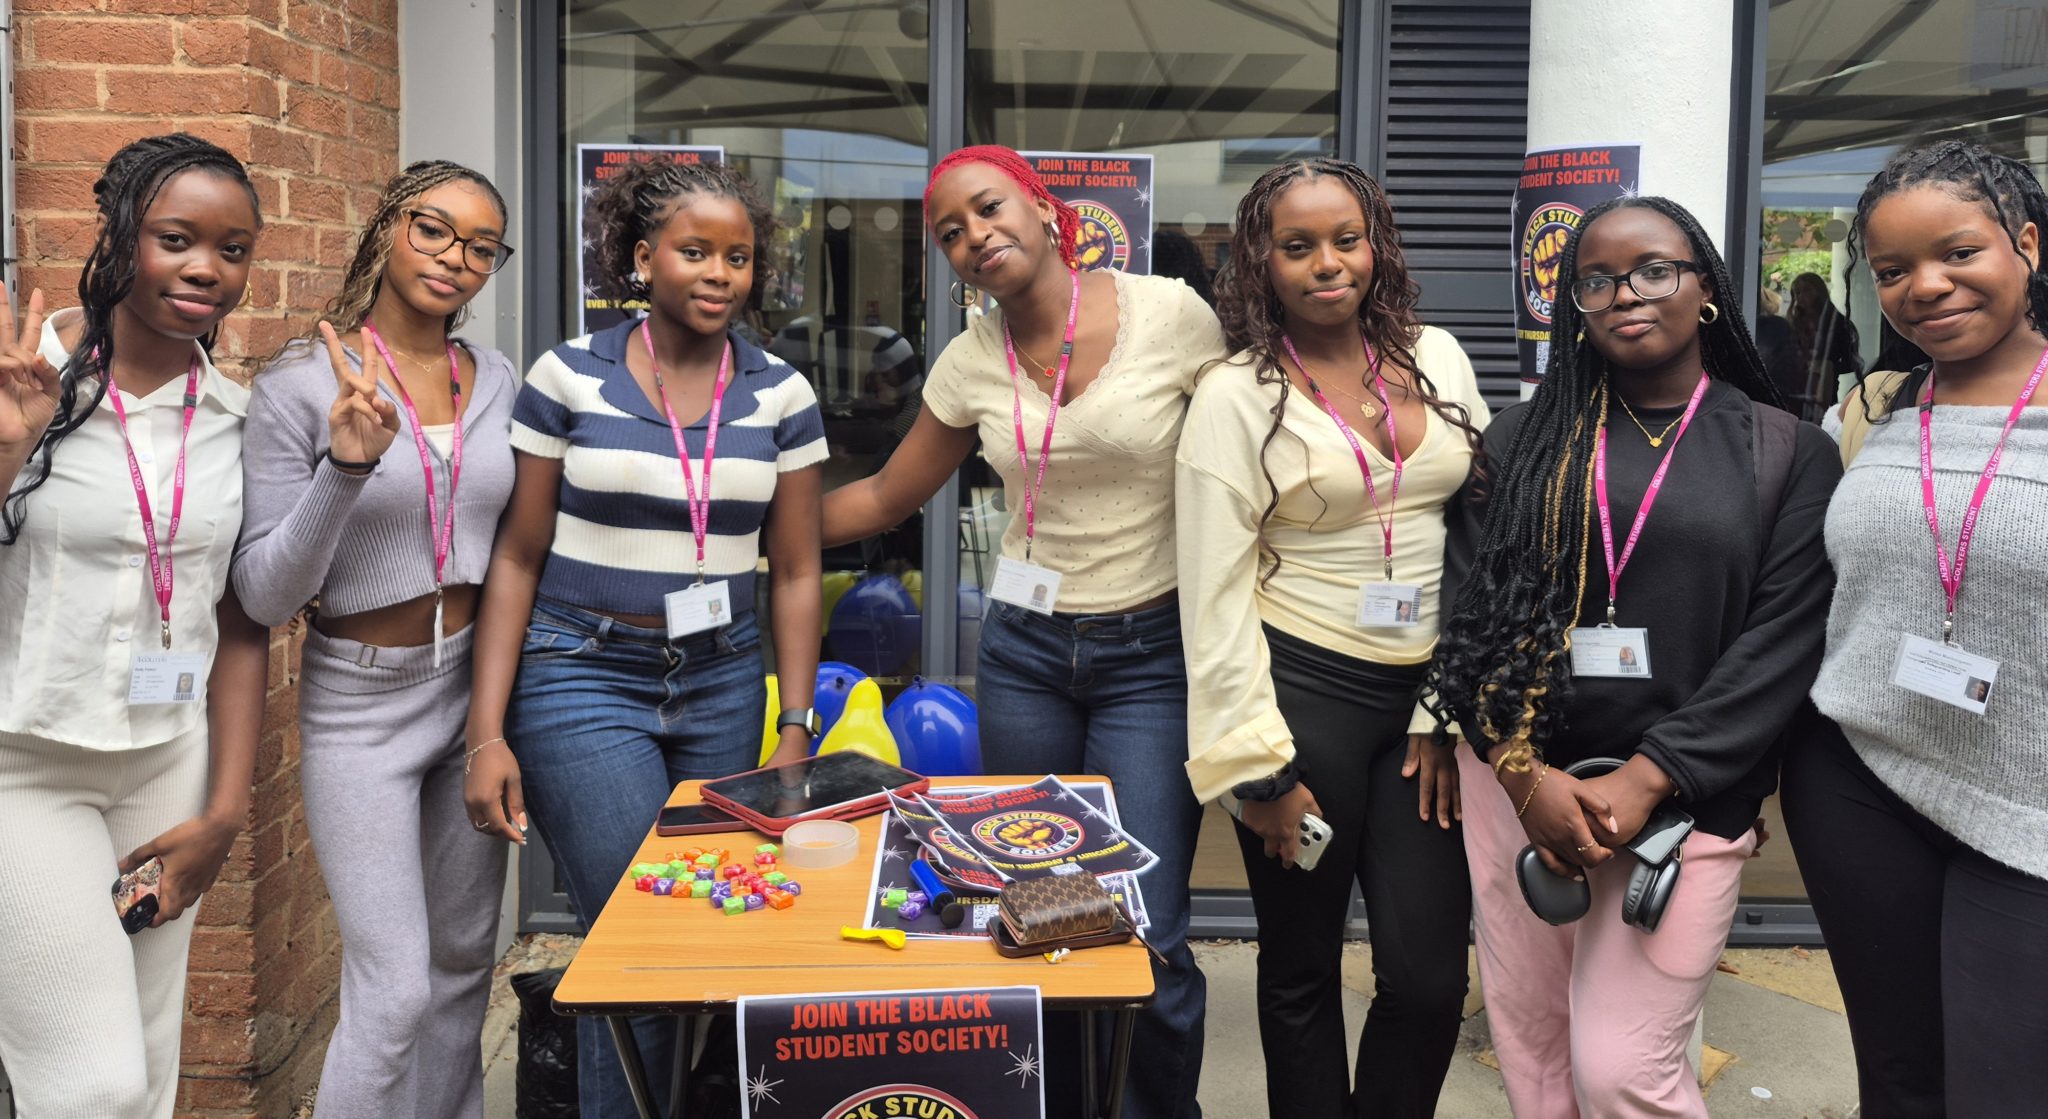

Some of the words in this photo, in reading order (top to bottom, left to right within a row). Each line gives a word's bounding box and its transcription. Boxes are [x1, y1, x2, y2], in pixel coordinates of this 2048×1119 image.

[603, 152, 630, 164] JOIN
[1037, 159, 1064, 171] JOIN
[1067, 160, 1088, 172] THE
[1091, 161, 1130, 173] BLACK
[1540, 154, 1560, 169] THE
[1562, 150, 1610, 167] BLACK
[1039, 174, 1082, 186] TUDENT
[1085, 175, 1137, 187] SOCIETY!
[1520, 172, 1553, 189] STUDENT
[1556, 167, 1620, 185] SOCIETY!
[1078, 206, 1125, 243] STUDENT
[1525, 213, 1546, 254] BLACK
[586, 299, 612, 309] EVER
[1600, 506, 1611, 542] COLLYERS
[1629, 511, 1646, 542] STUDENT
[1954, 541, 1968, 581] COLLYERS
[1962, 506, 1978, 541] STUDENT
[1003, 812, 1069, 824] STUDENT
[1008, 833, 1078, 856] SOCIETY
[791, 1002, 847, 1030] JOIN
[855, 997, 901, 1025] THE
[909, 993, 992, 1022] BLACK
[775, 1032, 889, 1061] STUDENT
[897, 1024, 1009, 1053] SOCIETY!
